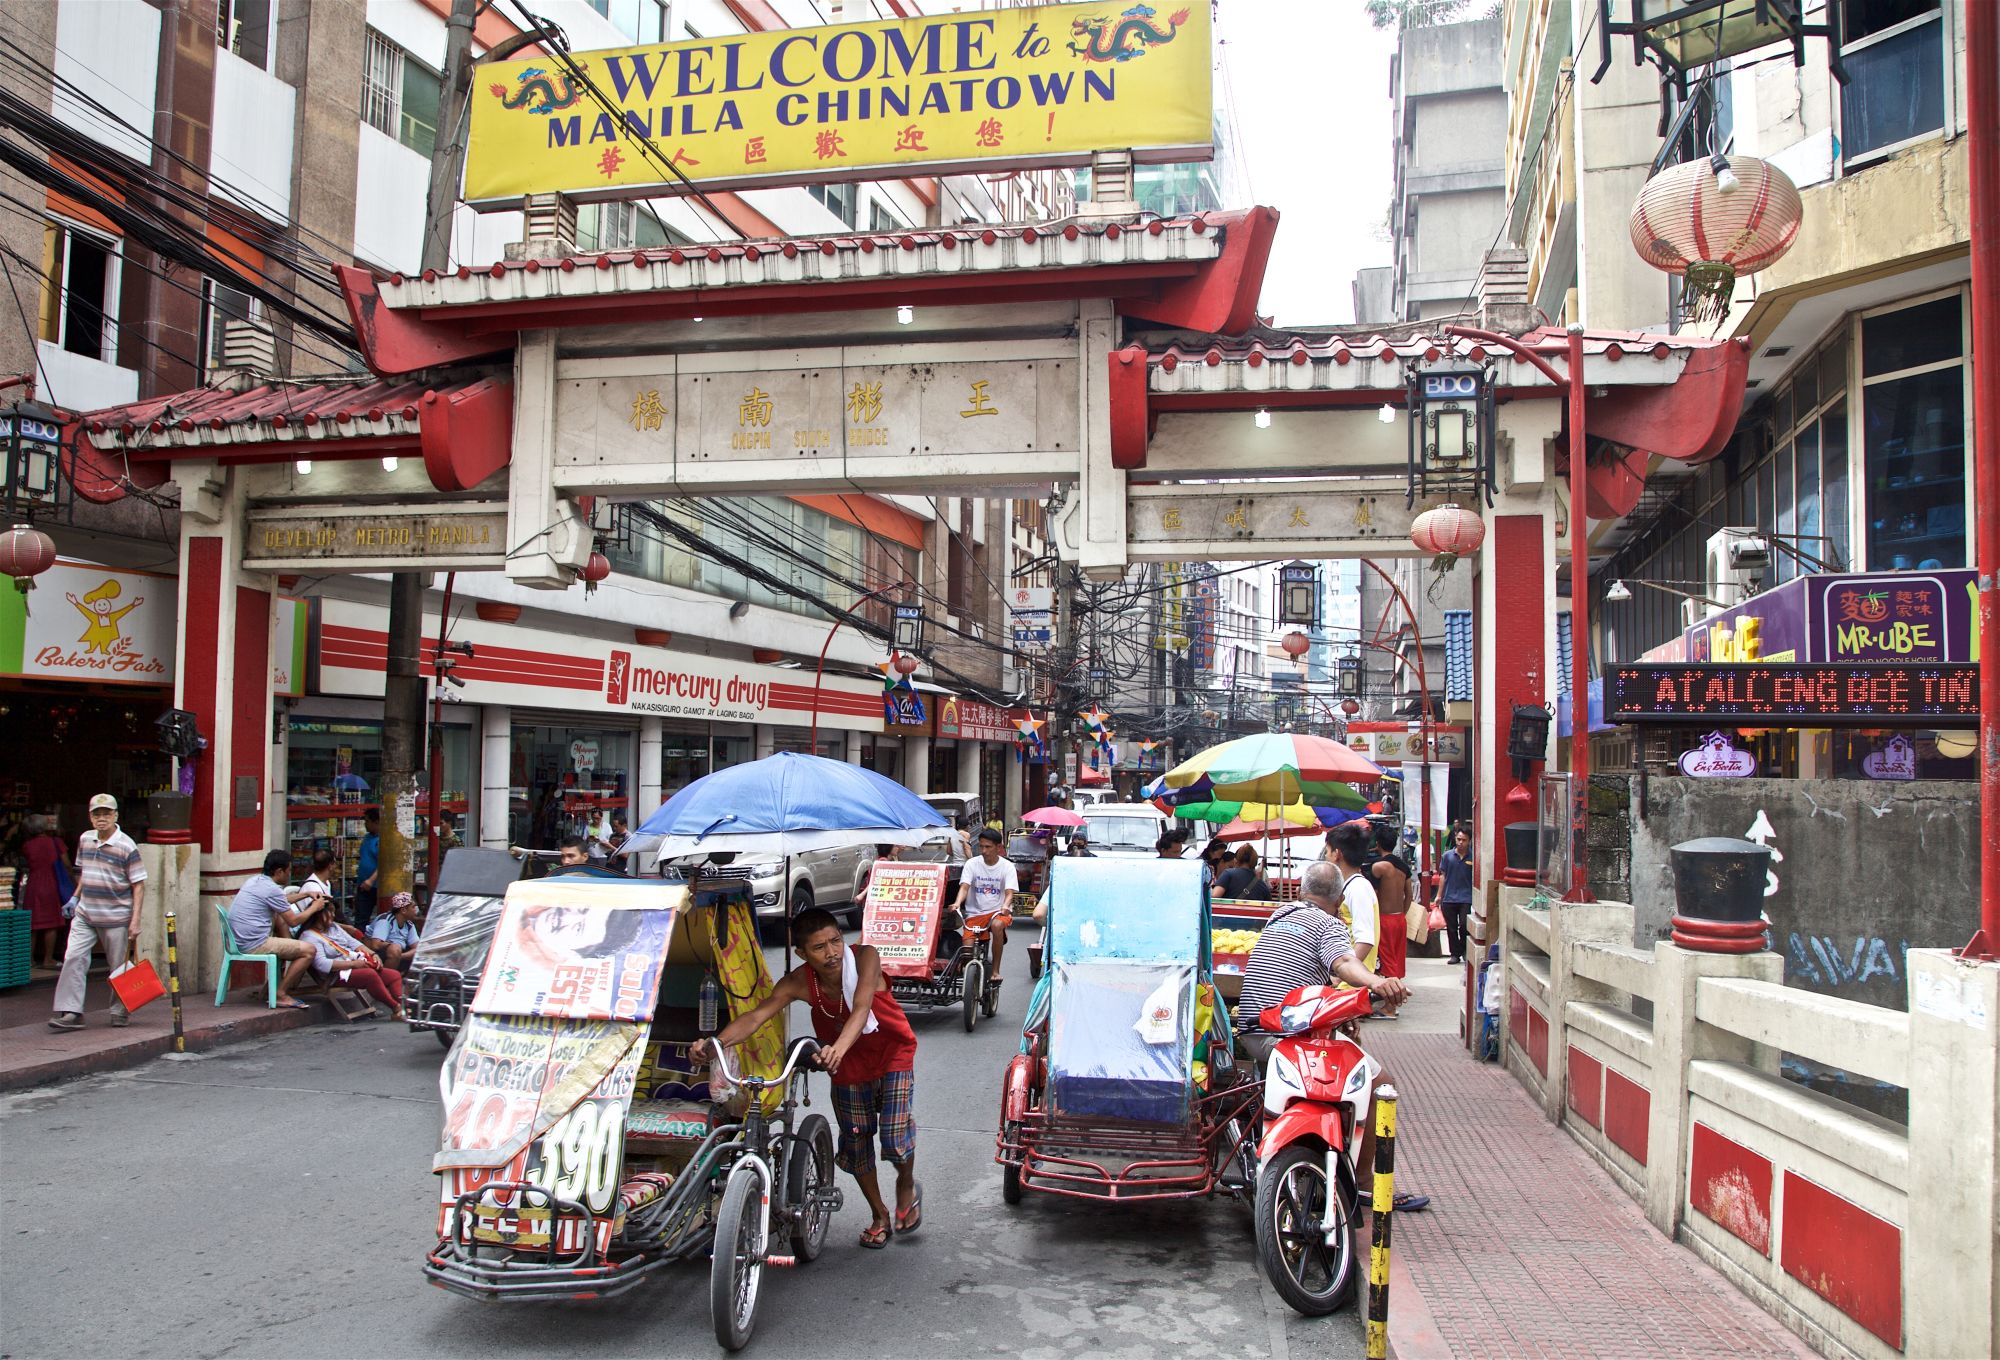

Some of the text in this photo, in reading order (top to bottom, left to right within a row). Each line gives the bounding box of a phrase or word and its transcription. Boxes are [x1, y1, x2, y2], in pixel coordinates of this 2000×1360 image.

[602, 19, 1051, 103] WELCOME to
[547, 67, 1115, 150] MANILA CHINATOWN
[1426, 376, 1476, 395] BDO
[20, 418, 59, 439] BDO
[732, 431, 771, 450] ONGPIN
[793, 431, 830, 448] SOUTH
[264, 528, 337, 548] DEVELOP
[1287, 569, 1312, 579] BDO
[114, 652, 166, 673] Fair
[274, 667, 288, 685] air
[632, 667, 767, 711] mercury drug
[1657, 679, 1971, 702] AT ALL ENG BEE TIN
[631, 702, 681, 714] NAKASISIGURO
[683, 706, 706, 716] GAMOT
[717, 709, 738, 719] LAGING
[738, 711, 754, 720] BAGO
[1694, 761, 1711, 772] Eng
[1729, 761, 1743, 771] Tin
[876, 868, 938, 878] OVERNIGHT PROMO
[578, 967, 599, 1004] ERAP
[470, 1030, 500, 1053] Near
[460, 1051, 547, 1093] PROMO
